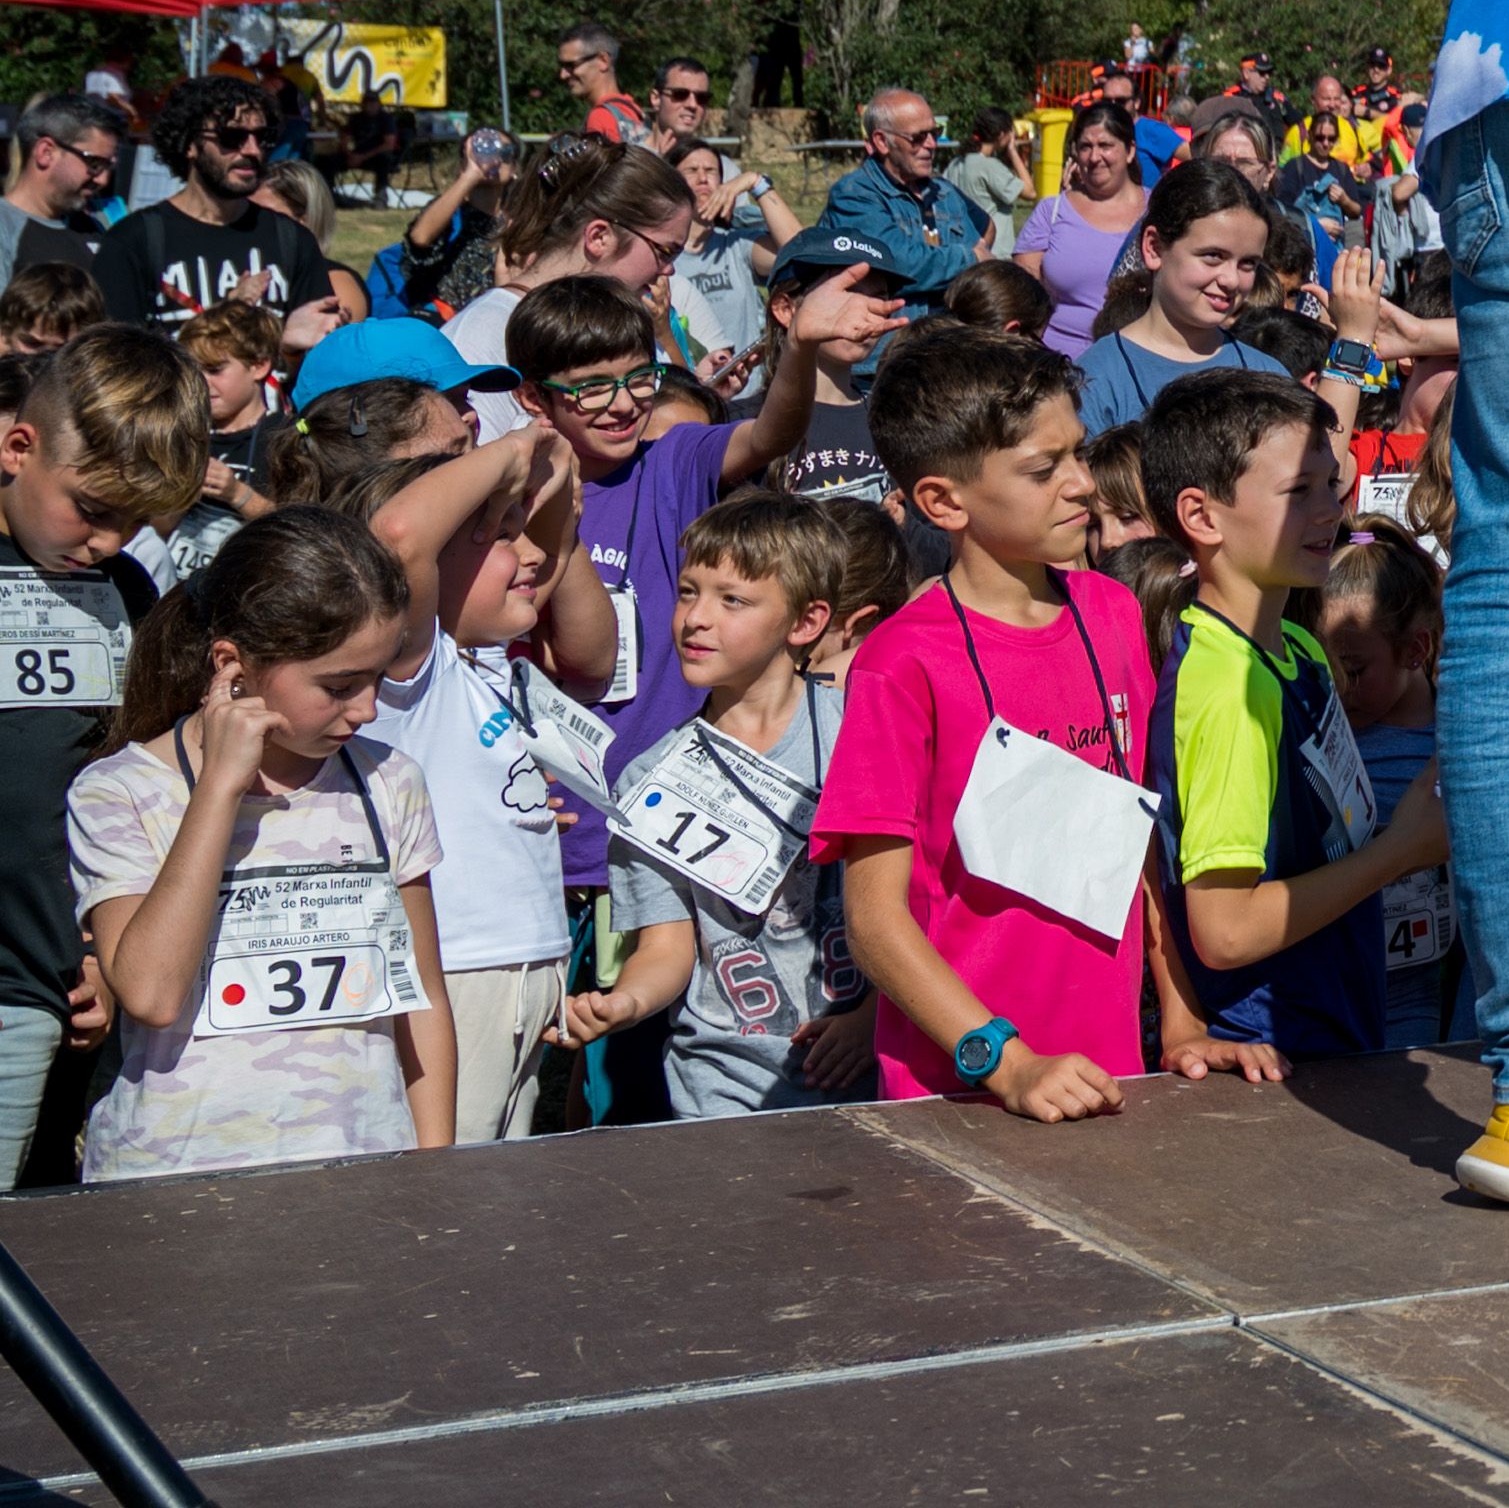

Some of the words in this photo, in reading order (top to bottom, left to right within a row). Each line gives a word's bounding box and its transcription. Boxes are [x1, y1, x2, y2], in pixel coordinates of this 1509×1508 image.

[853, 240, 883, 259] LaLiga
[14, 584, 25, 594] 52
[27, 584, 54, 594] Marxa
[22, 598, 32, 607] de
[15, 648, 75, 696] 85
[656, 811, 731, 865] 17
[275, 881, 291, 893] 52
[292, 879, 328, 892] Marxa
[330, 876, 372, 890] Infantil
[281, 897, 296, 909] de
[300, 894, 363, 909] Regularitat
[248, 939, 268, 950] IRIS
[269, 935, 310, 948] ARAUJO
[312, 932, 350, 944] ARTERO
[268, 955, 346, 1016] 37
[716, 949, 781, 1022] 6
